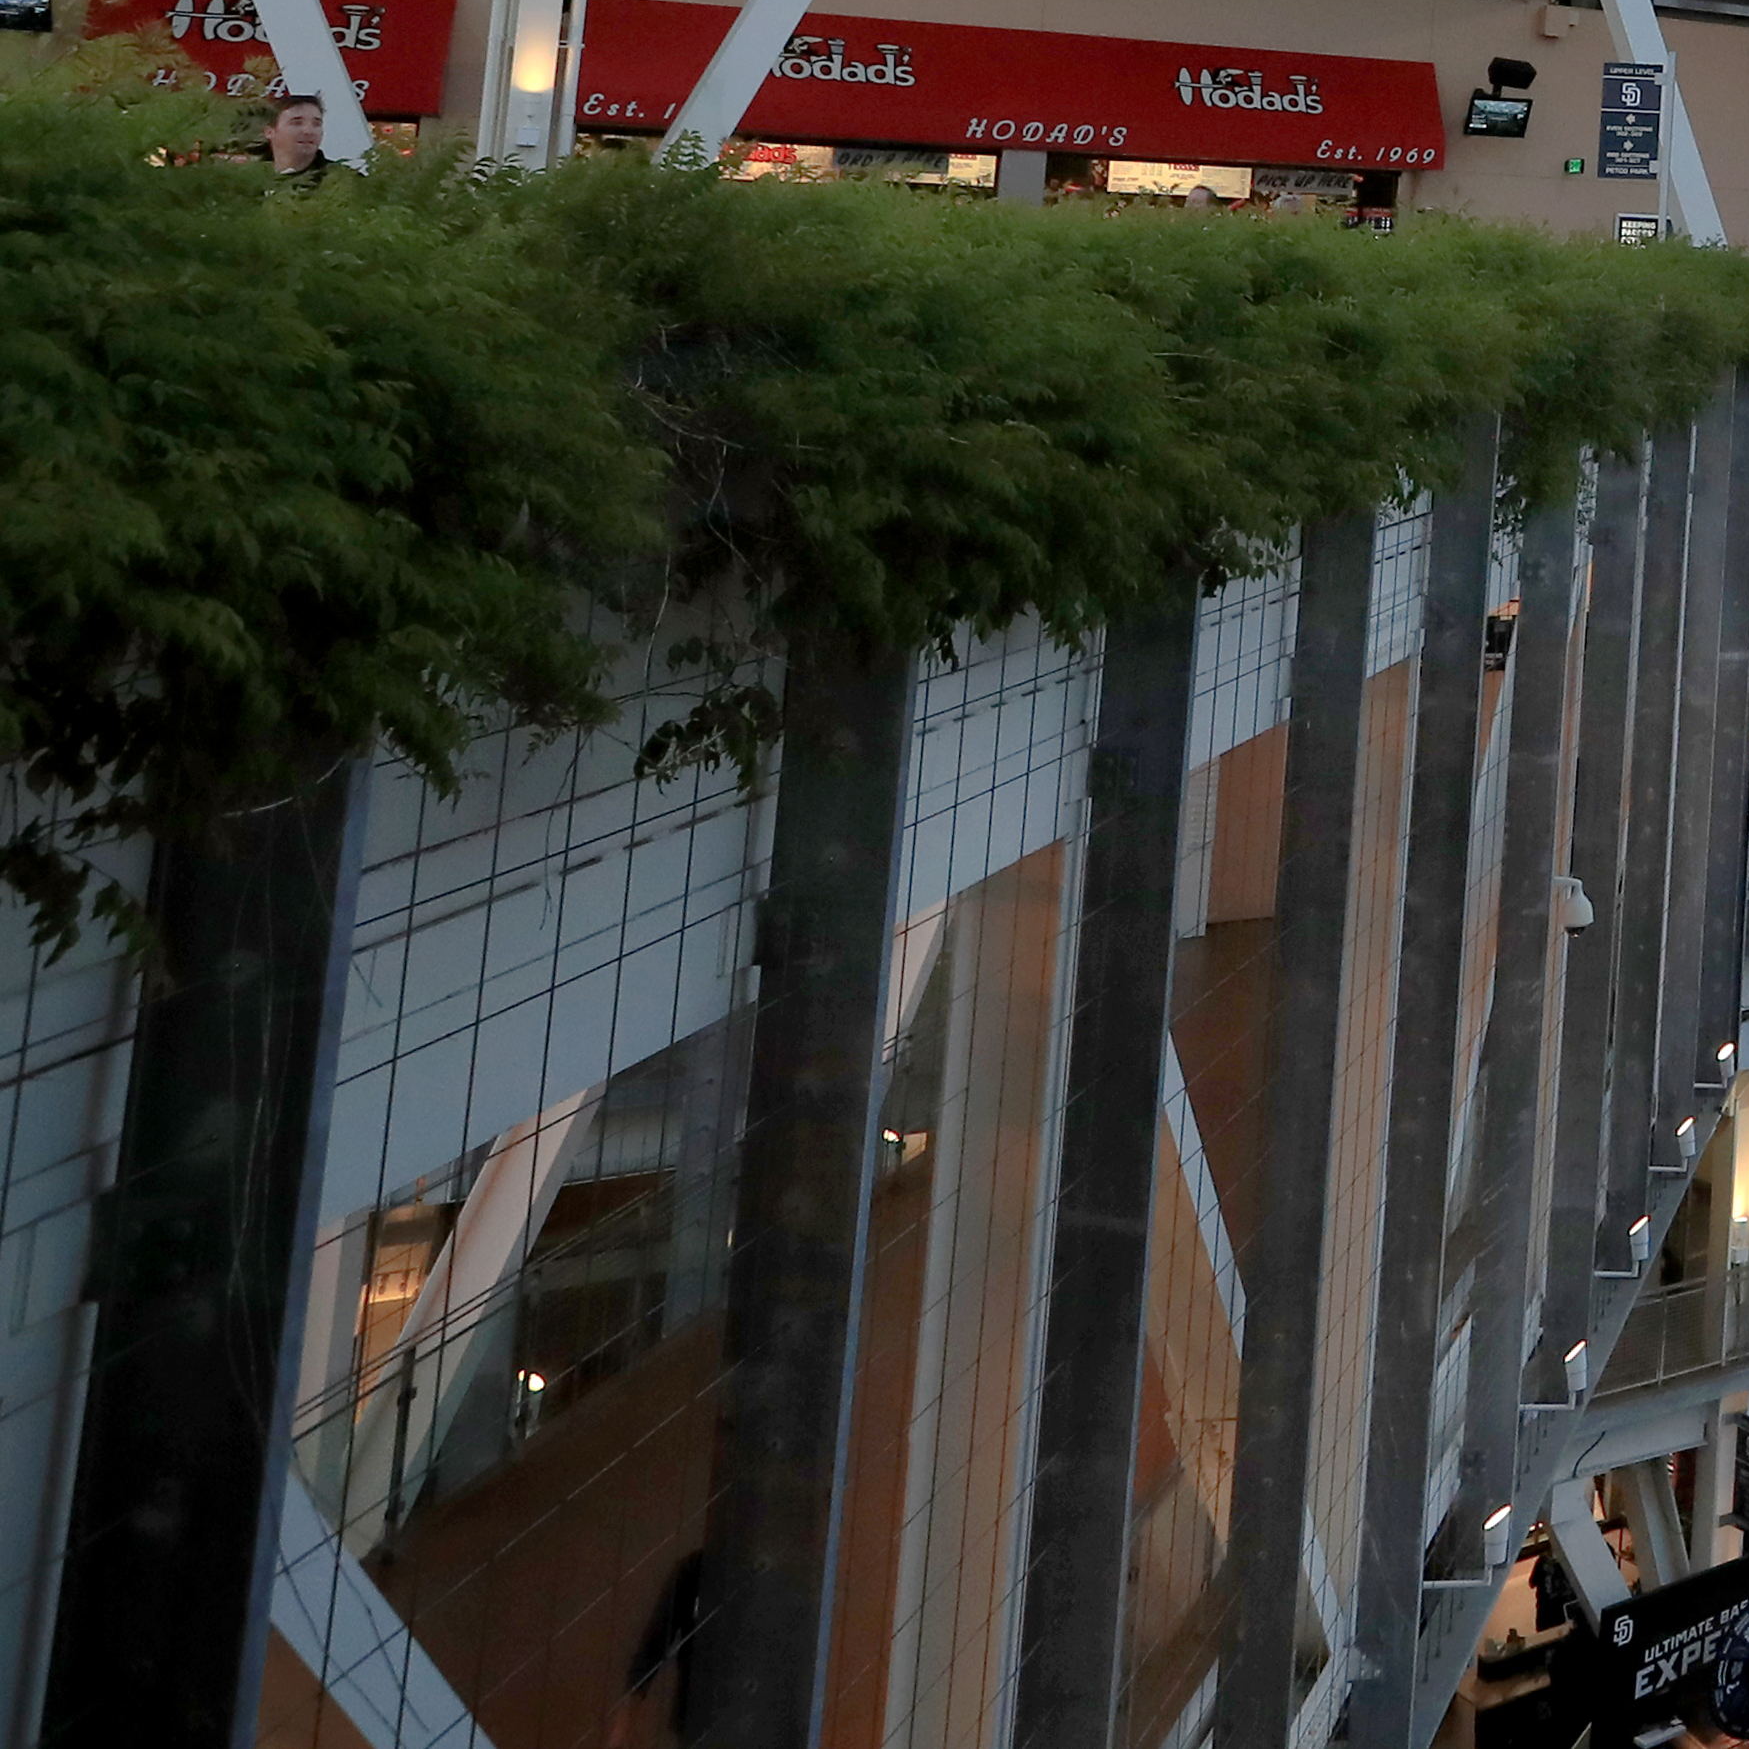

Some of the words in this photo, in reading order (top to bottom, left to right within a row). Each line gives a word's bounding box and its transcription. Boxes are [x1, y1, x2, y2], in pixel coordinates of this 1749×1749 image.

[1174, 67, 1324, 115] Hodad's
[583, 93, 645, 119] Est.
[965, 117, 1128, 148] HODAD'S
[1316, 139, 1363, 160] Est.
[1376, 146, 1436, 165] 1969
[1256, 171, 1290, 188] PICK
[1294, 172, 1315, 189] UP
[1317, 173, 1351, 190] HERE
[1605, 166, 1628, 175] PETCO
[1629, 167, 1649, 175] PARK
[1613, 1614, 1634, 1647] SD
[1644, 1616, 1714, 1664] ULTIMATE
